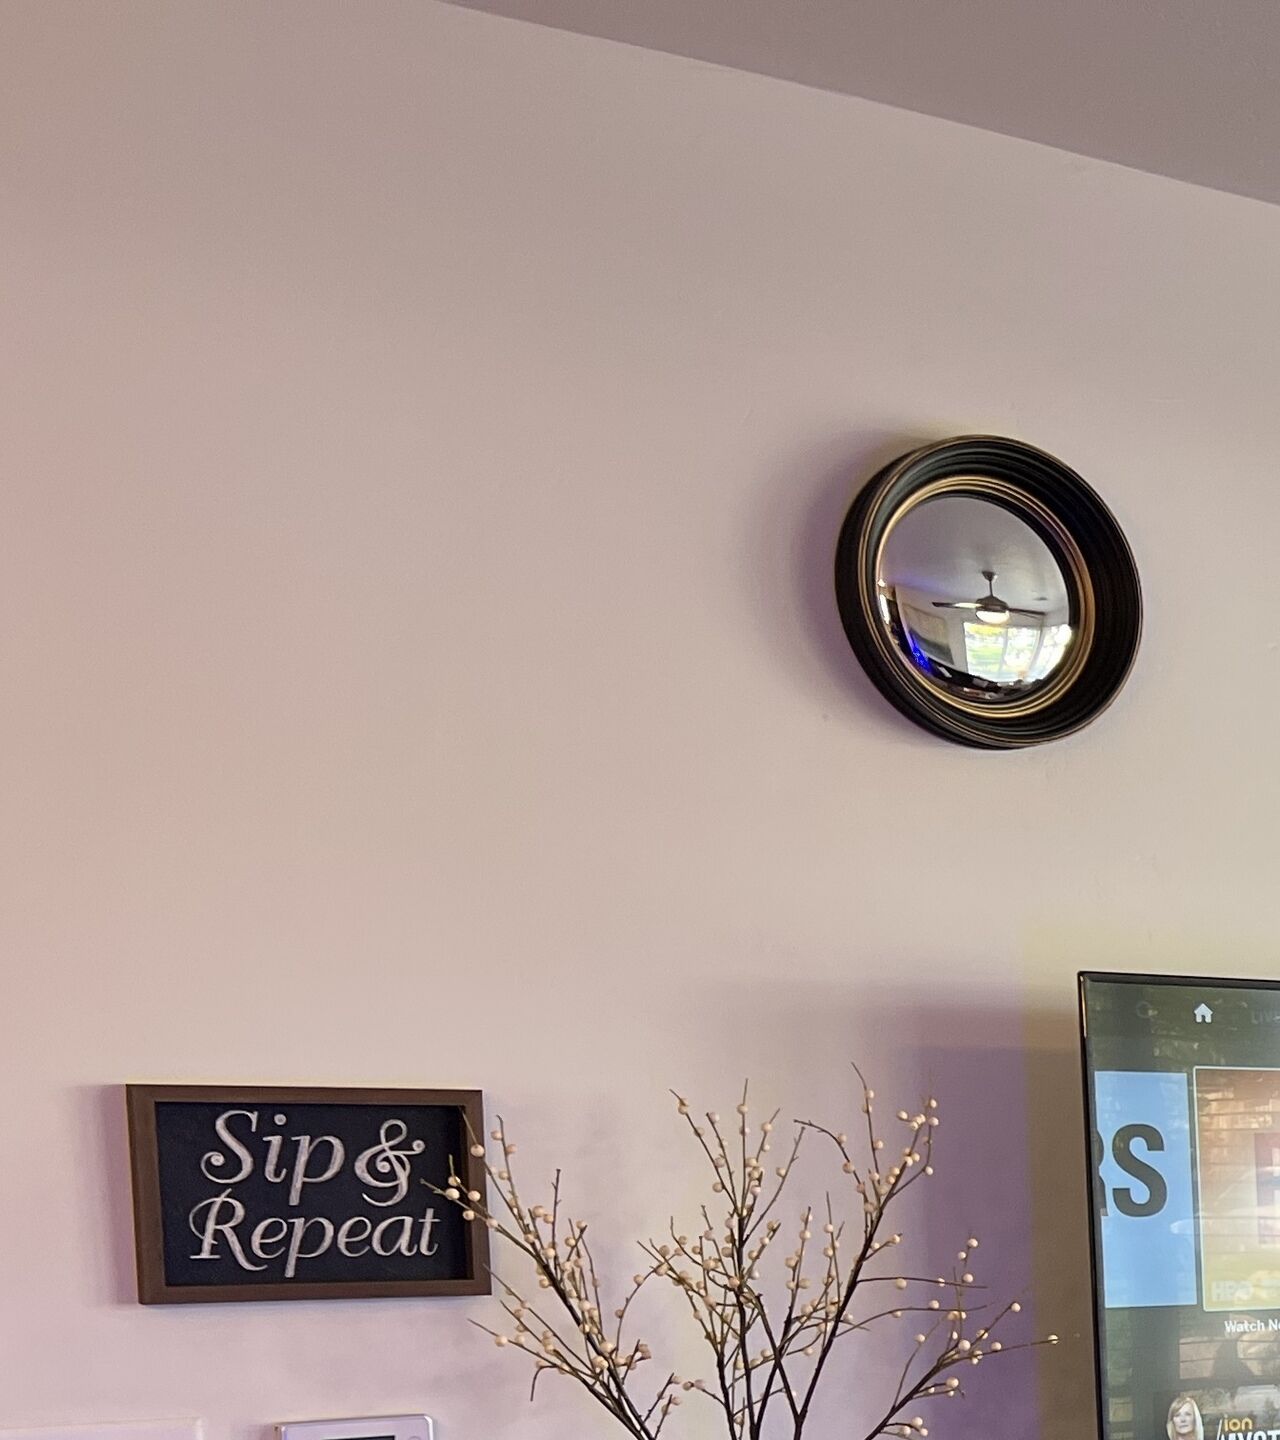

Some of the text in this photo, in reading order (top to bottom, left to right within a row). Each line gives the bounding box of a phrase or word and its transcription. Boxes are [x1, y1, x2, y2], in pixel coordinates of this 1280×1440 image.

[200, 1110, 426, 1207] Sip &
[189, 1188, 442, 1279] Repeat
[1224, 1320, 1265, 1334] Watch
[1224, 1414, 1252, 1431] ion
